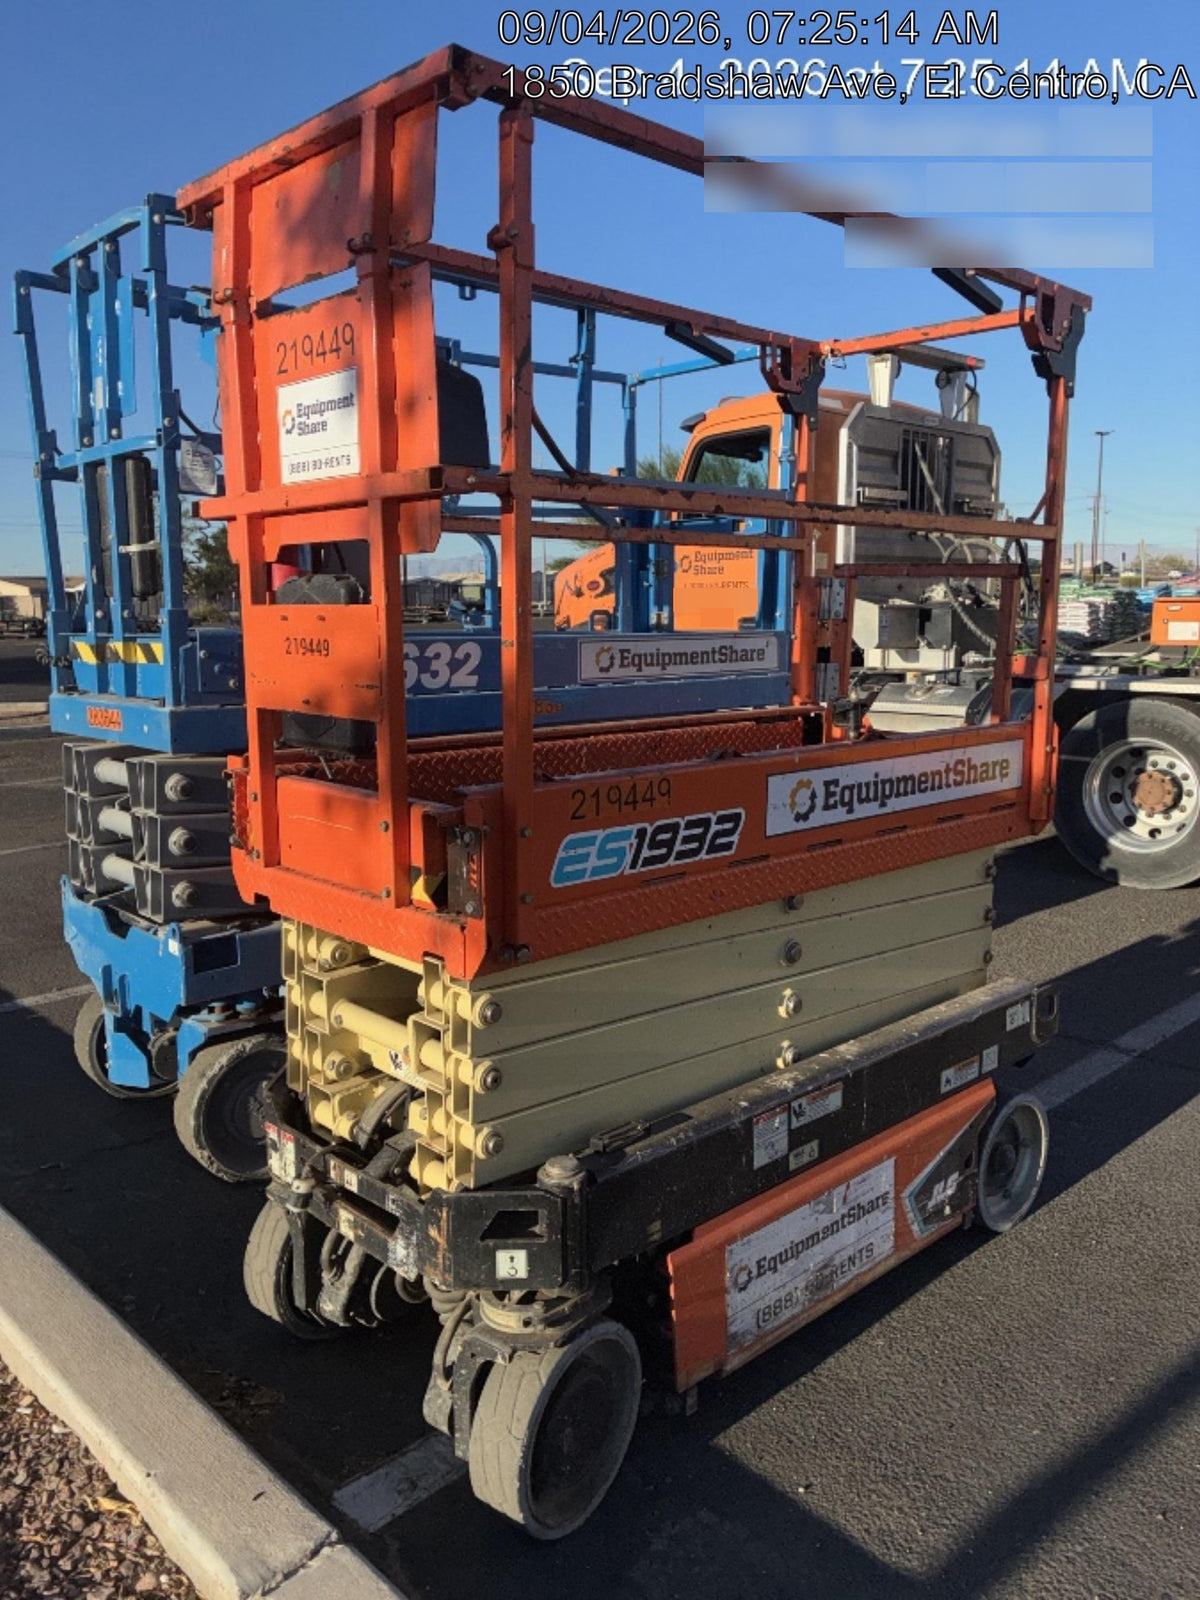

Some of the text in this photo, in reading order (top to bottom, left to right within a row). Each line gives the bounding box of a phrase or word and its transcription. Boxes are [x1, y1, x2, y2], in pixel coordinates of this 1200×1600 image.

[276, 322, 355, 375] 219449
[296, 392, 355, 420] Equipment
[297, 420, 328, 436] Share
[693, 565, 724, 575] Share
[694, 549, 753, 564] Equipment
[284, 636, 330, 657] 219449
[618, 645, 766, 672] EquipmentShare
[570, 777, 672, 820] 219449
[821, 757, 1010, 814] EquipmentShare
[551, 808, 744, 886] ES1932
[756, 1190, 890, 1279] EquipmentShare
